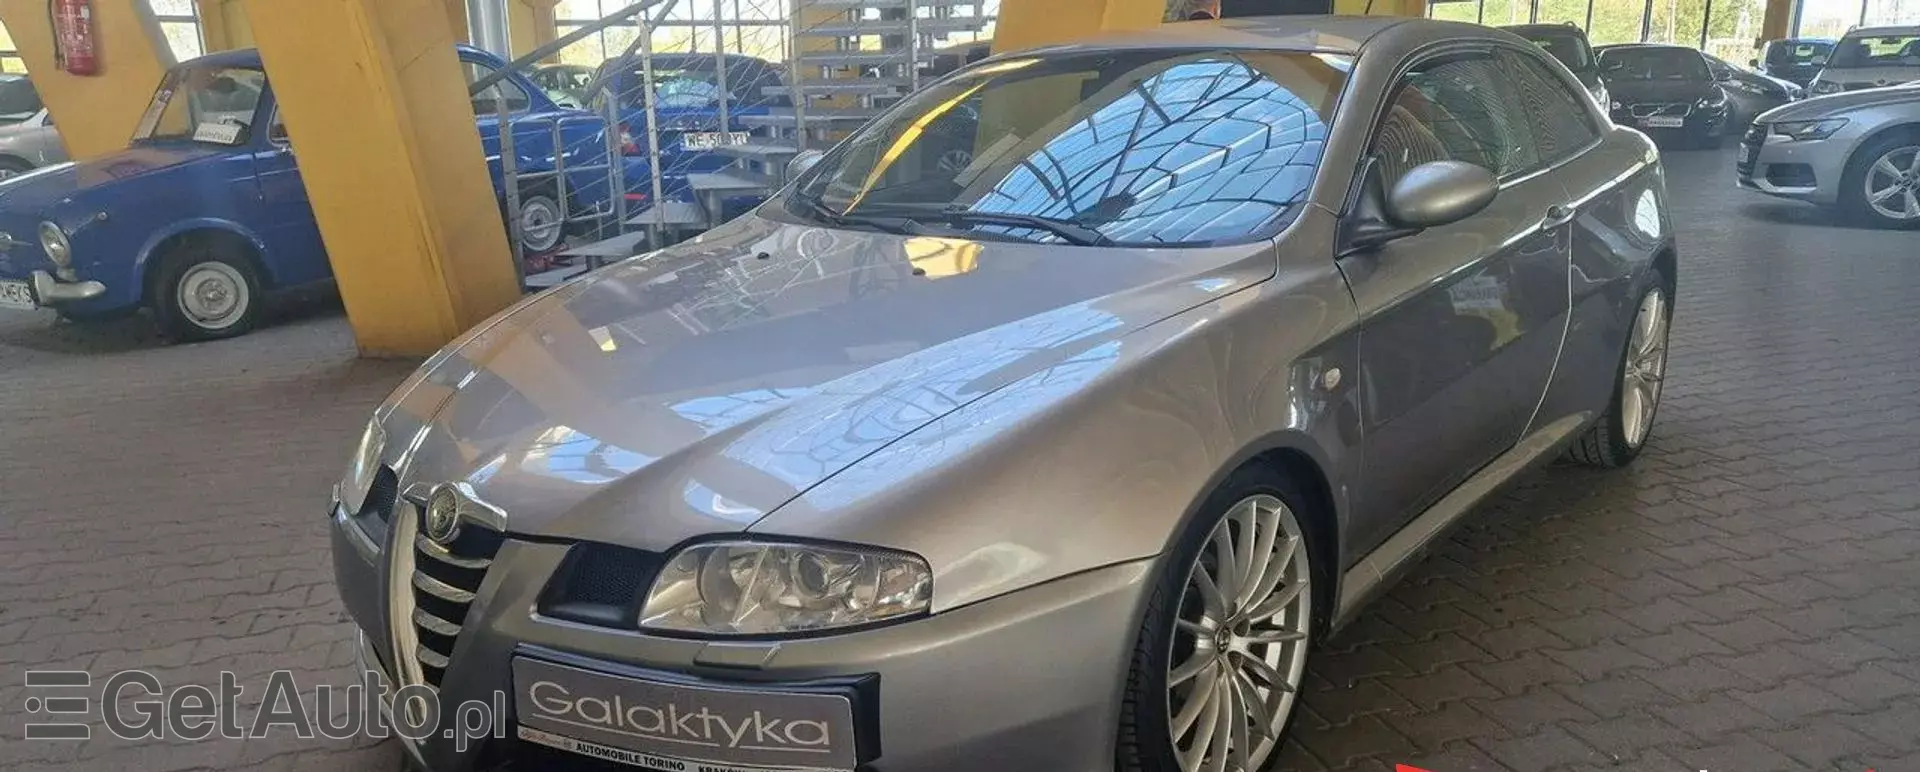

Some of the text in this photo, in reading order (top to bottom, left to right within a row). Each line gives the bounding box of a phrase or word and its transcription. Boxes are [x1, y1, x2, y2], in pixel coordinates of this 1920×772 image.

[529, 680, 830, 748] Galaktyka
[576, 743, 641, 763] AUTOMOBILE
[643, 756, 685, 771] TORINO
